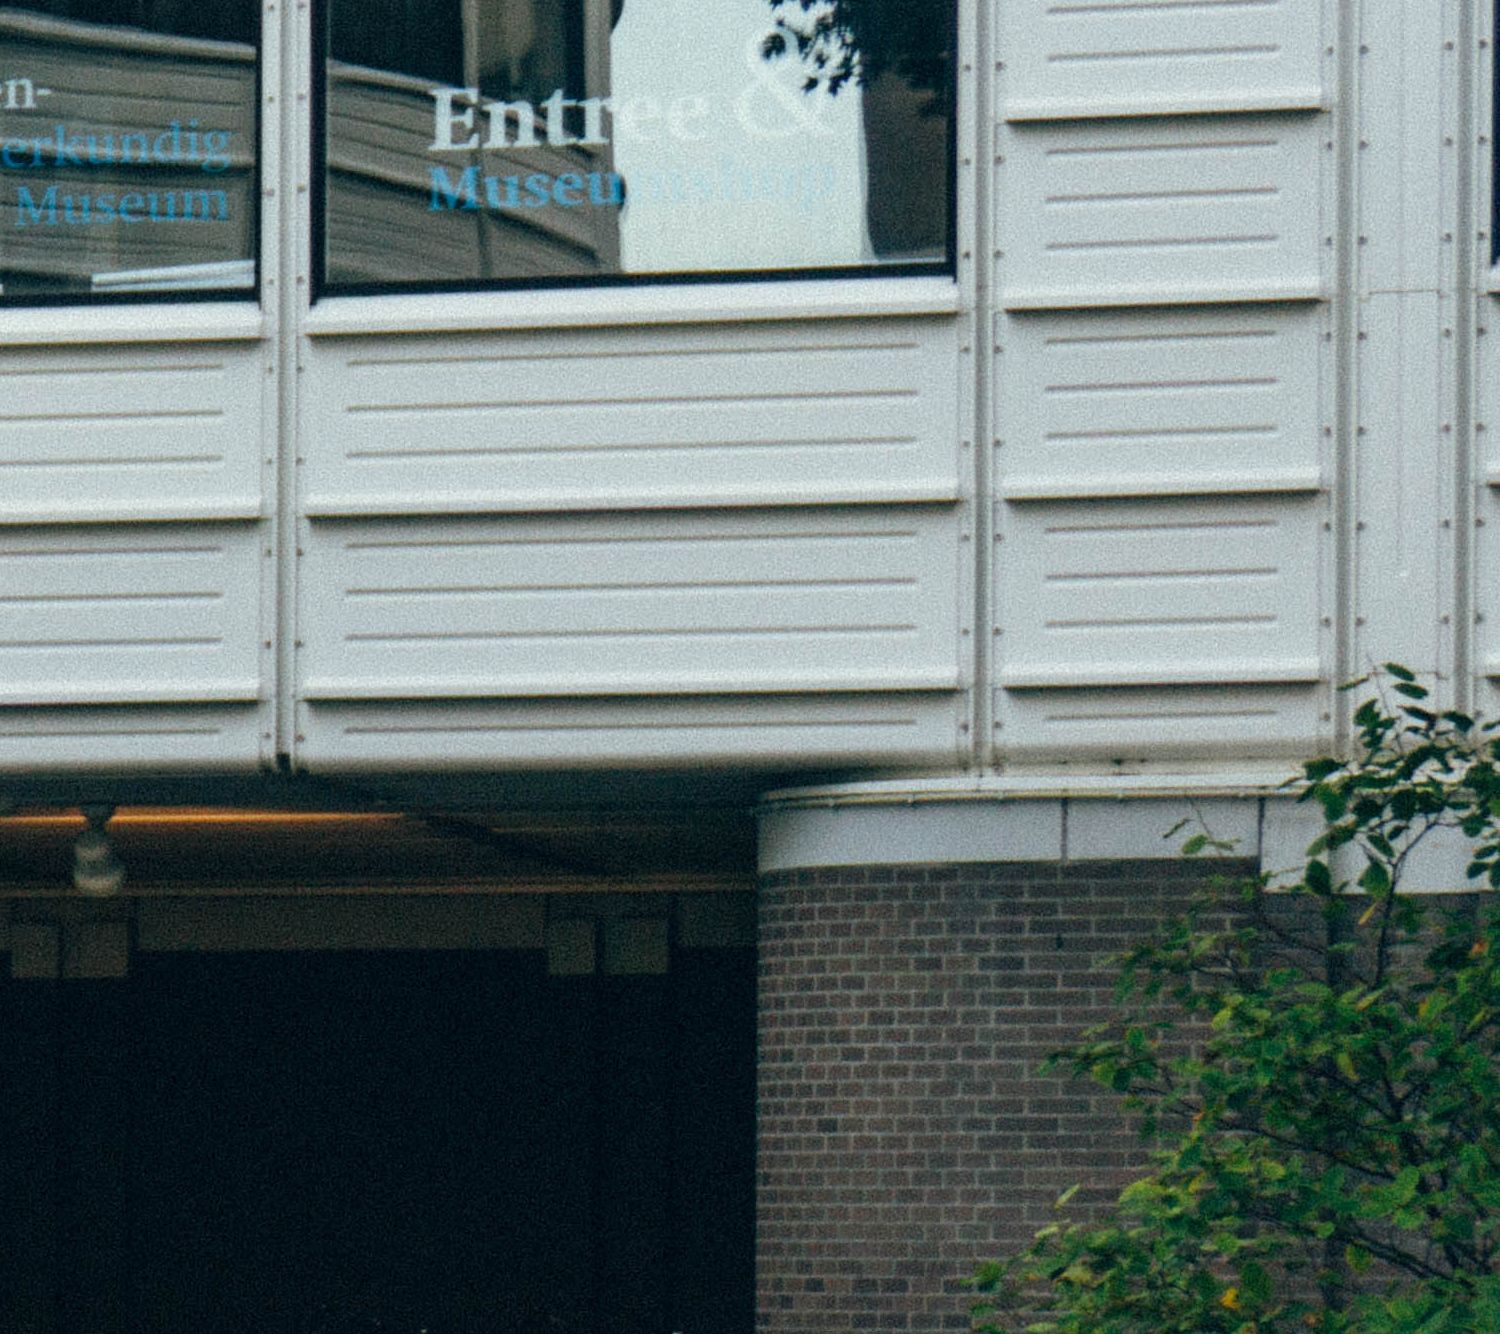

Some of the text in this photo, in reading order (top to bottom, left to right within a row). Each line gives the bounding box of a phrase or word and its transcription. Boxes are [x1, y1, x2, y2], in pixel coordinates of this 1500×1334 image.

[427, 28, 836, 151] Entree &
[14, 184, 229, 227] Museum
